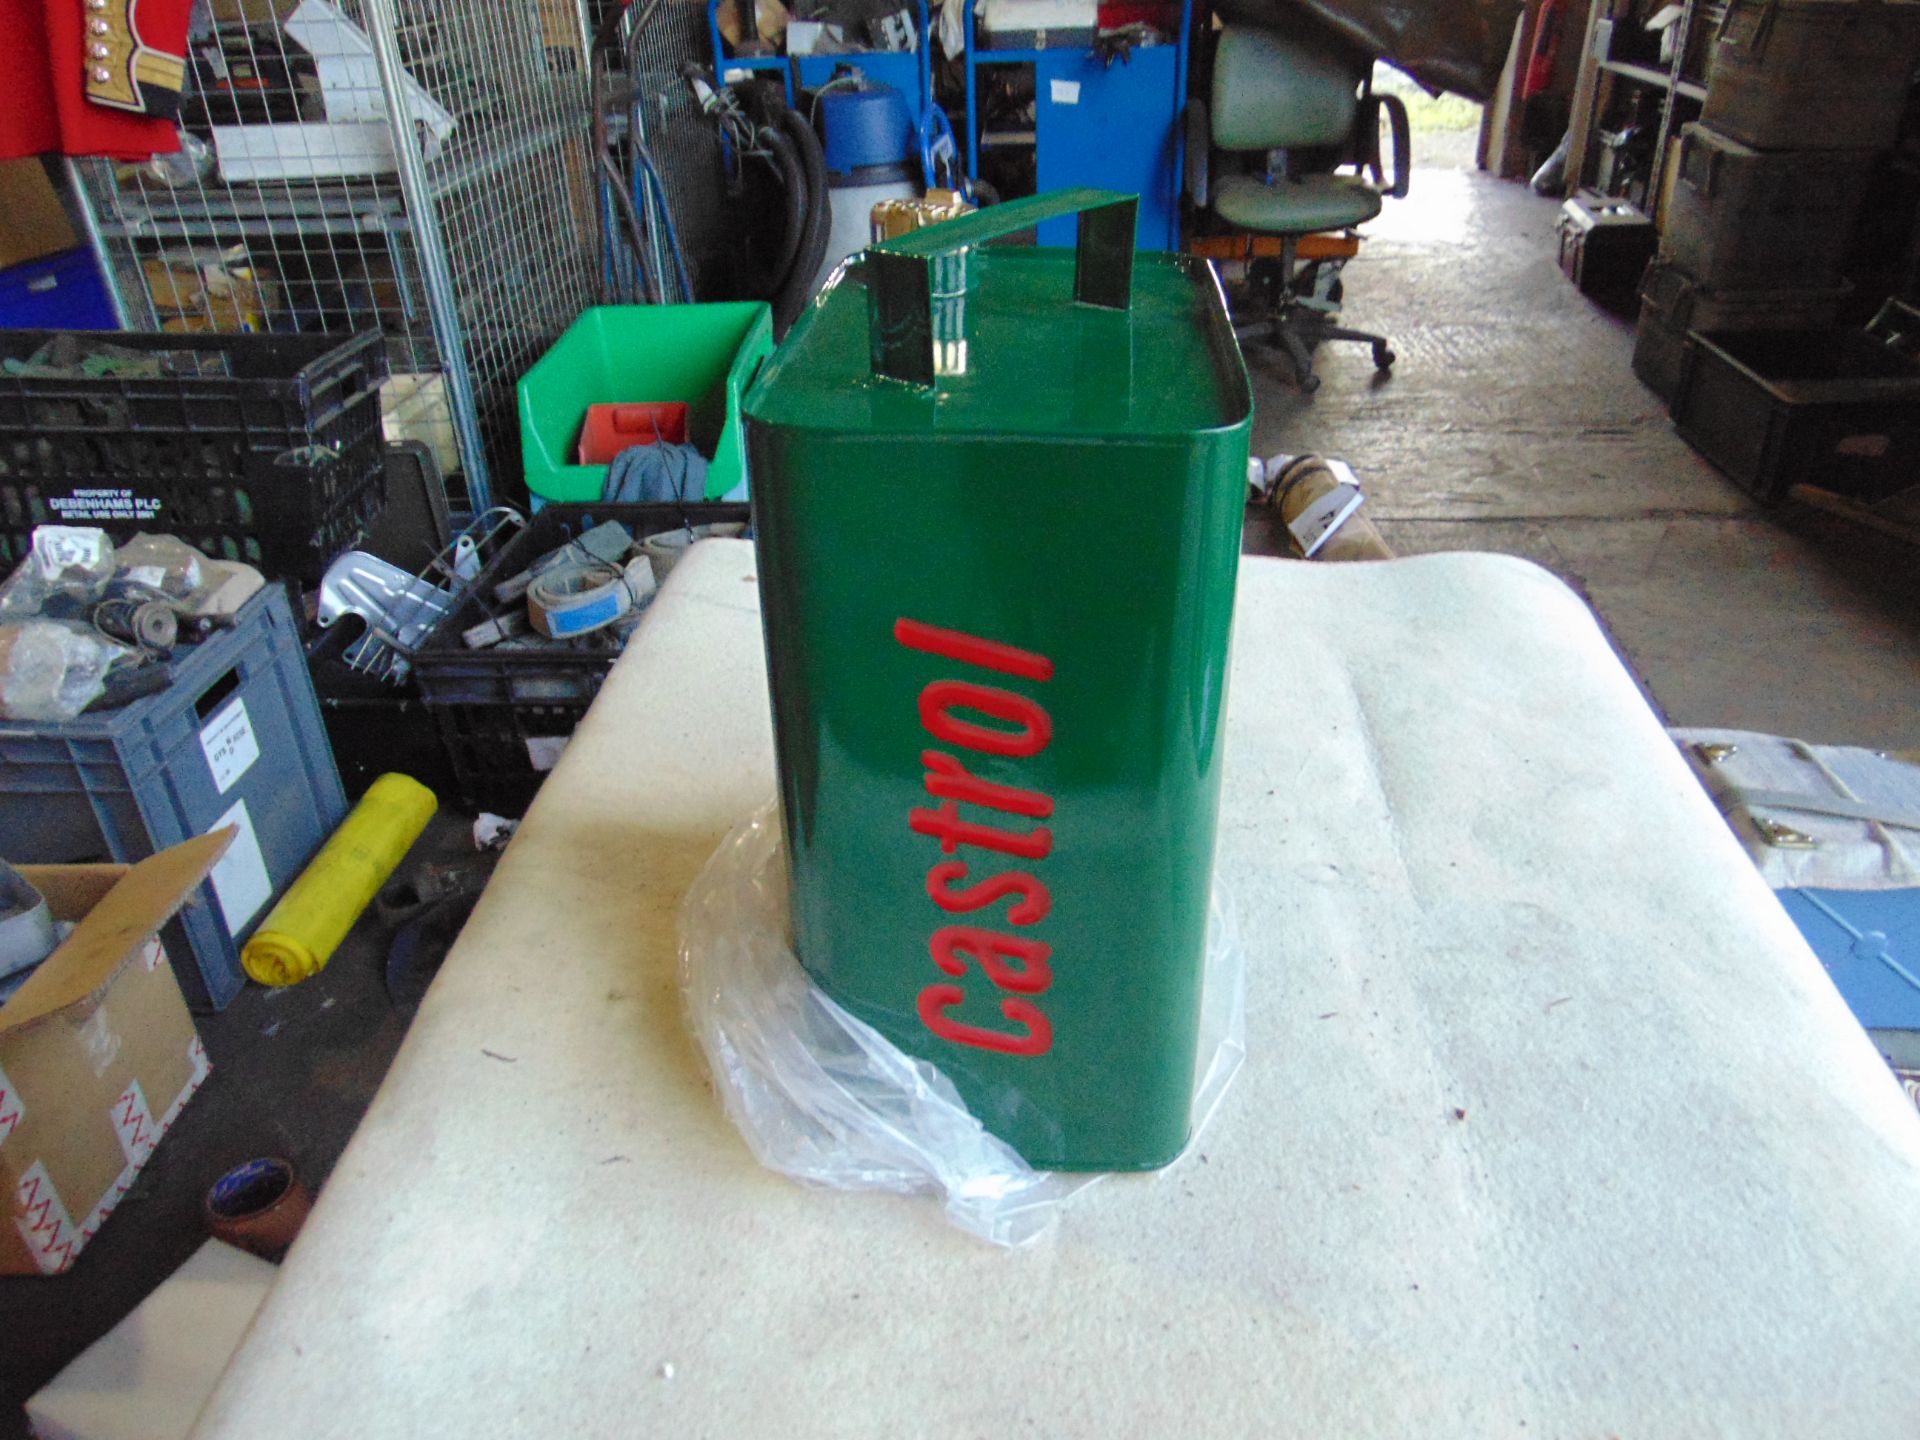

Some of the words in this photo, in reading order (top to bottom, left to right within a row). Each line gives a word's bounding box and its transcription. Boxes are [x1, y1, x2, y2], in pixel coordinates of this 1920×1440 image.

[50, 498, 133, 510] DEBENHAMS
[135, 499, 161, 510] PLC
[893, 617, 1055, 1057] Castrol
